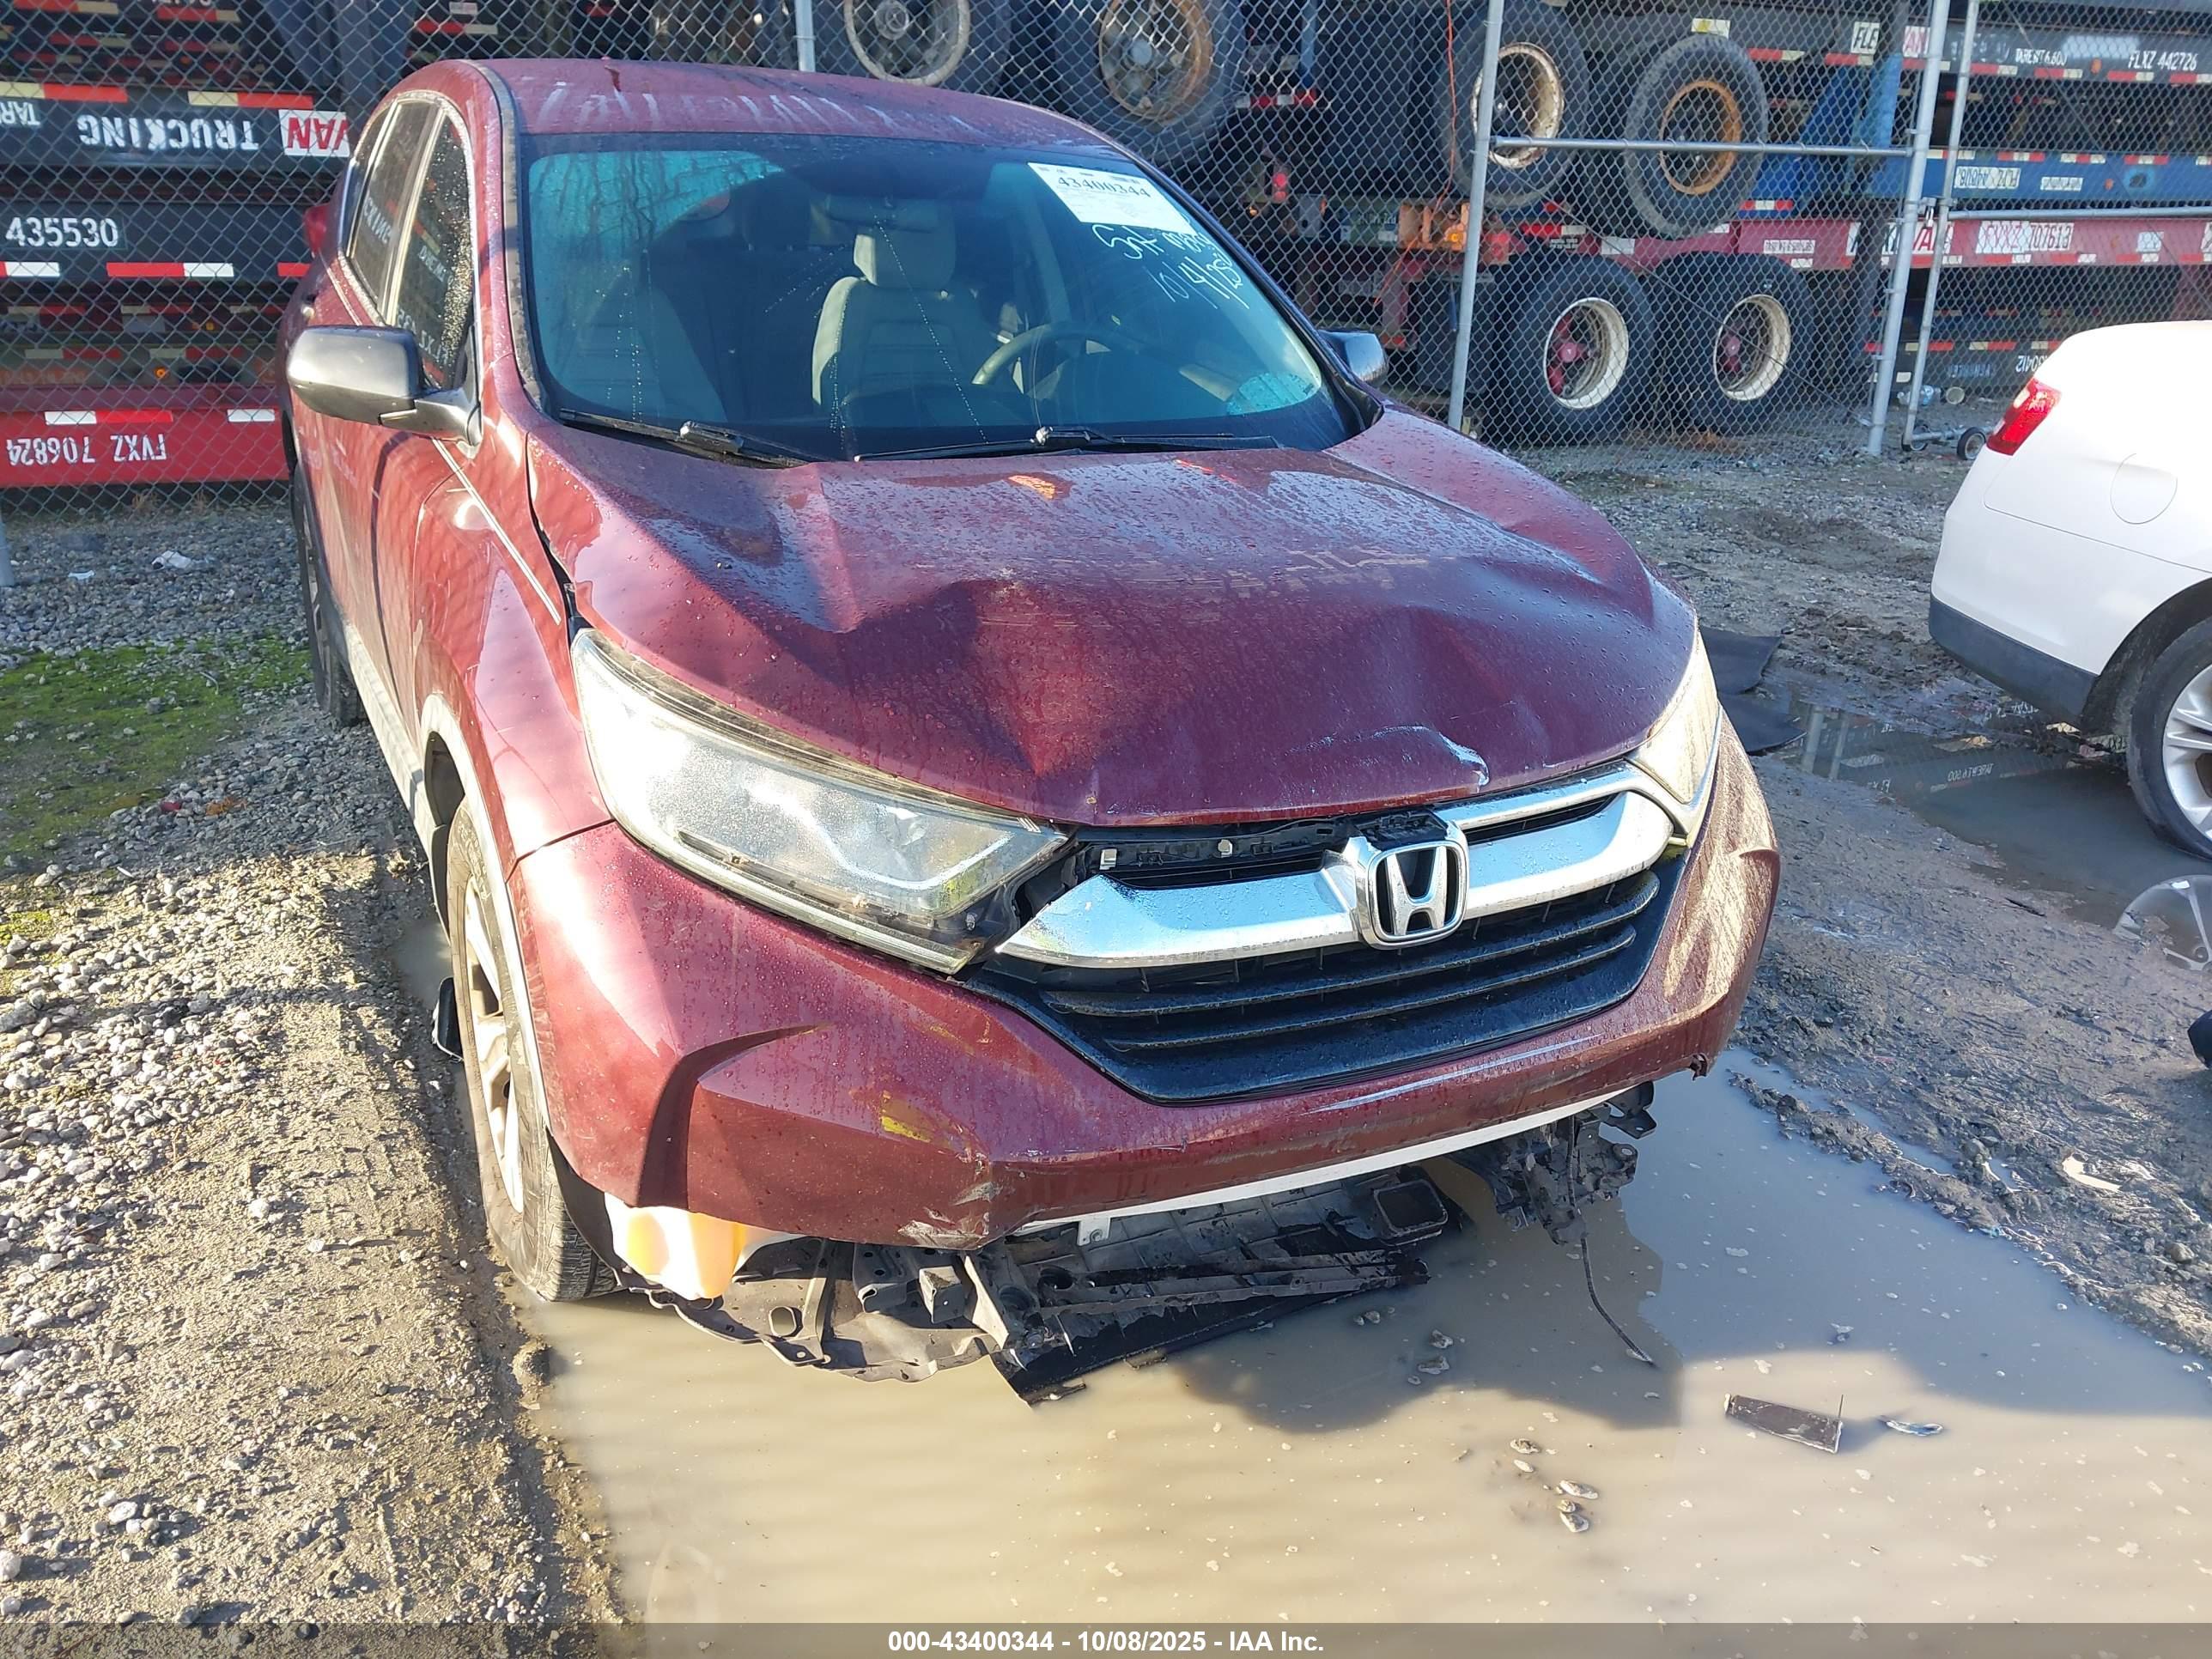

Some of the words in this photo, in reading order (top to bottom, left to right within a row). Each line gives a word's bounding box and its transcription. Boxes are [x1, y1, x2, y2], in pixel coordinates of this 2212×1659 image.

[78, 115, 259, 151] TRUCKING
[1057, 177, 1152, 198] 43400344
[5, 217, 119, 248] 435530
[6, 435, 96, 466] 706824
[109, 433, 167, 461] FVXZ
